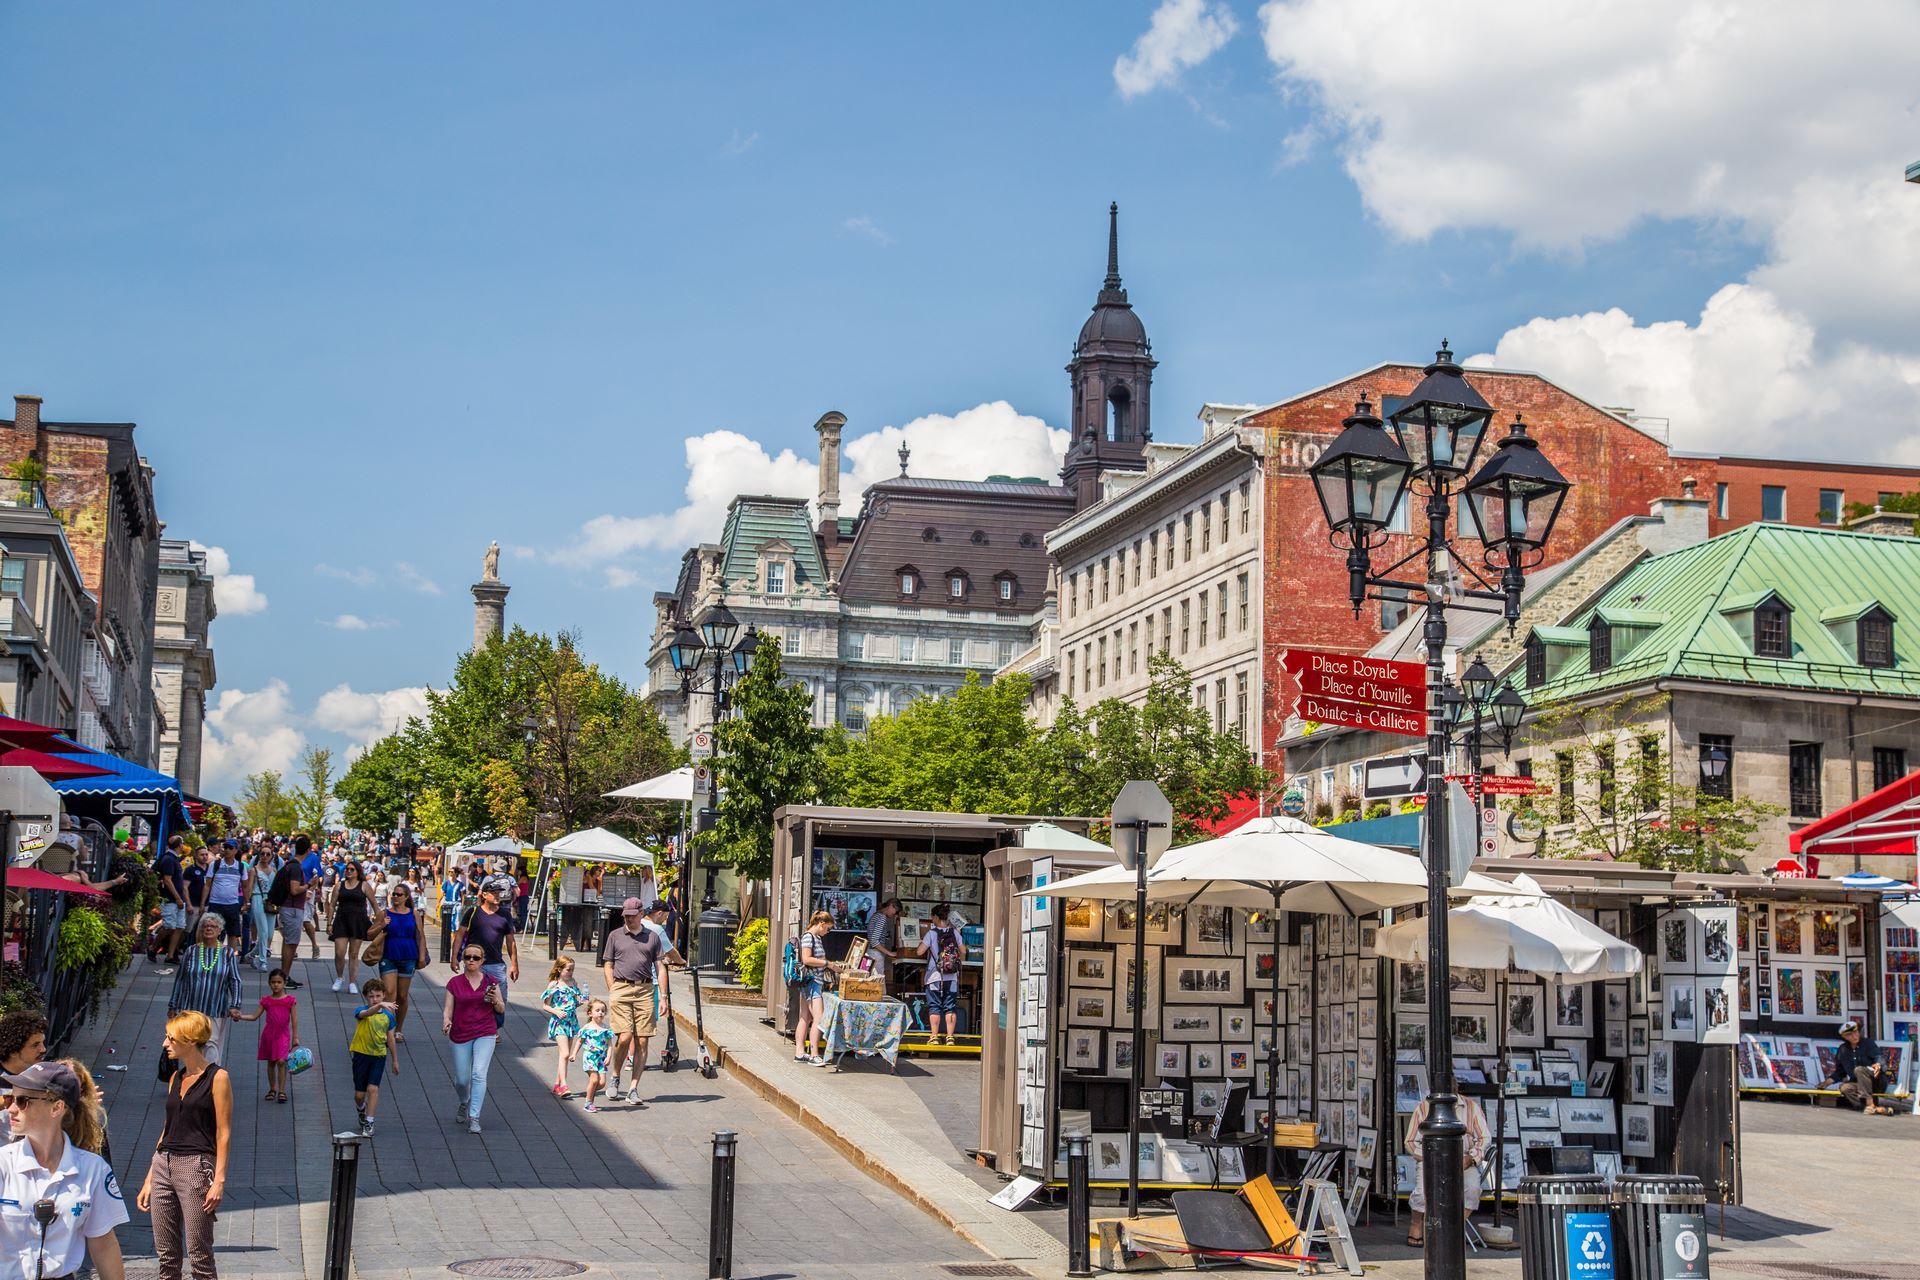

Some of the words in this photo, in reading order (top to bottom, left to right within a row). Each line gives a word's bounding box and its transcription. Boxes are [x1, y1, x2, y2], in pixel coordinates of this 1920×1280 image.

[1312, 656, 1348, 674] Place
[1353, 660, 1399, 680] Royale
[1321, 676, 1354, 695] Place
[1358, 681, 1412, 705] d'Youville
[1307, 701, 1419, 731] Pointe-à-Callière
